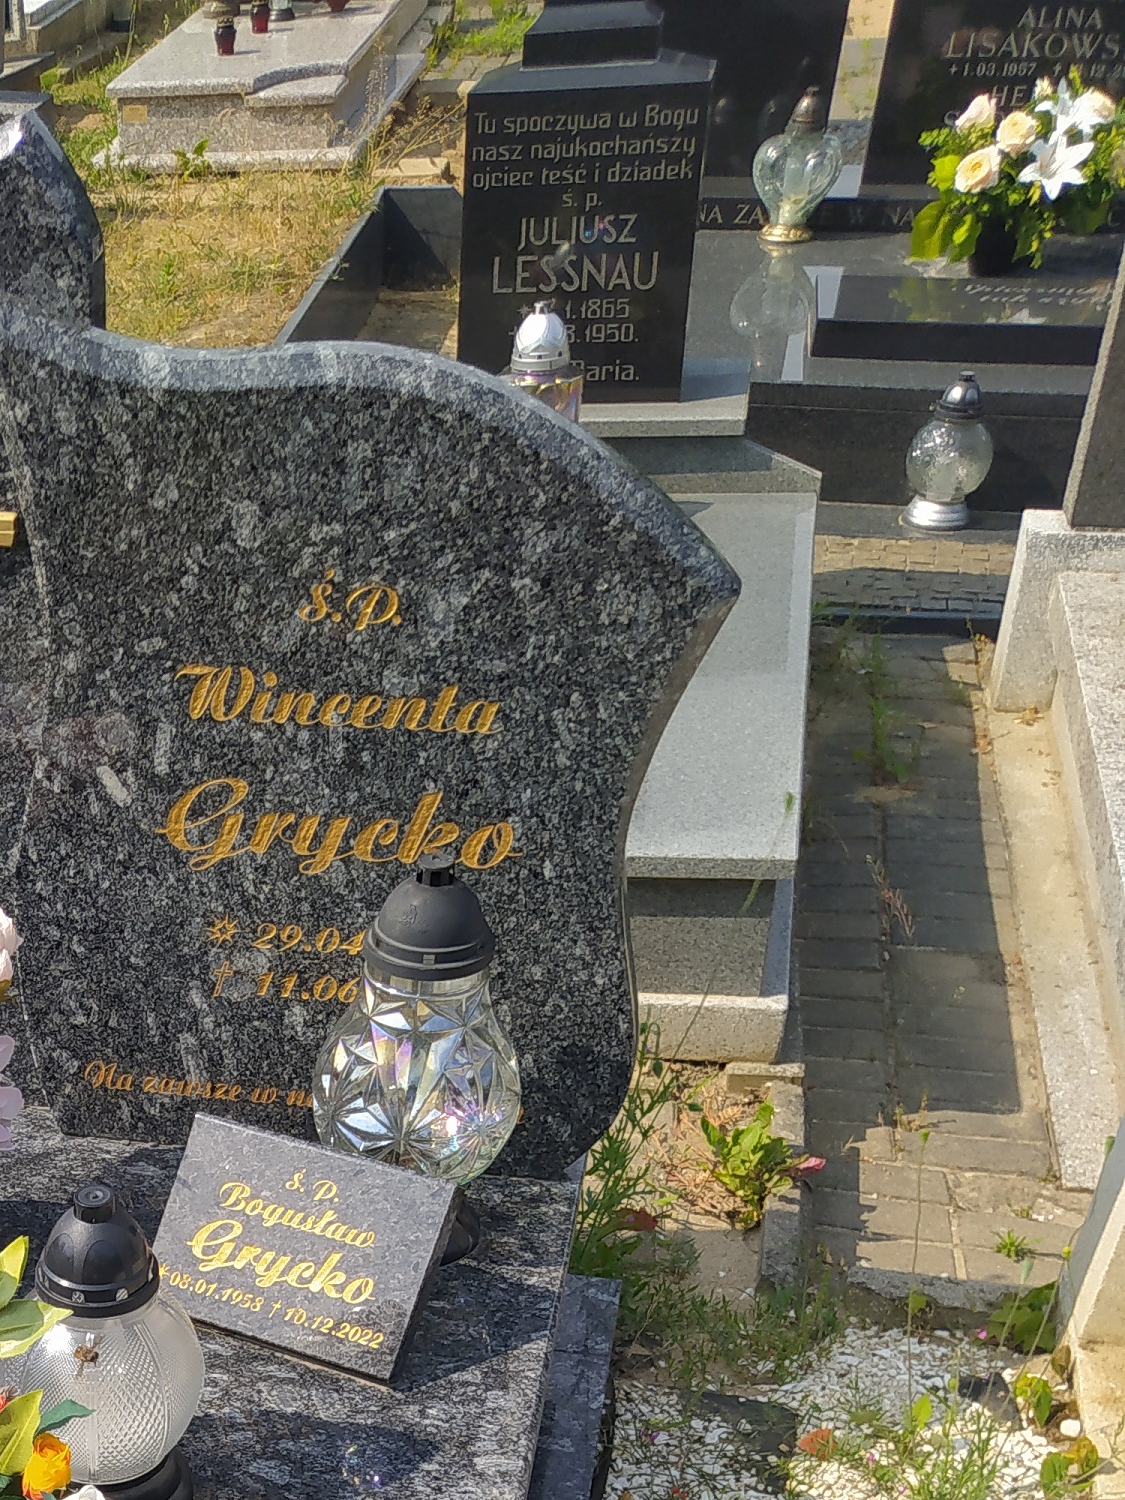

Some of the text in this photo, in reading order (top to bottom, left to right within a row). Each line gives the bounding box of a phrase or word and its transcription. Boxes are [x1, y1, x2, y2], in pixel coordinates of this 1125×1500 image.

[1017, 5, 1102, 29] ALINA
[945, 31, 1125, 58] LISAKOWS
[474, 104, 699, 137] Tu spoczywa w Bogu
[472, 133, 696, 163] nasz najukochańszy
[472, 158, 692, 190] ojciec teść i dziadek
[518, 213, 637, 251] JULIUSZ
[492, 251, 659, 294] LESSNAU
[175, 664, 502, 734] Wincenta
[155, 777, 522, 874] Grycko
[83, 1060, 133, 1094] Na
[252, 1086, 278, 1104] w
[219, 1182, 375, 1248] Bogusław
[186, 1219, 376, 1304] Grycko
